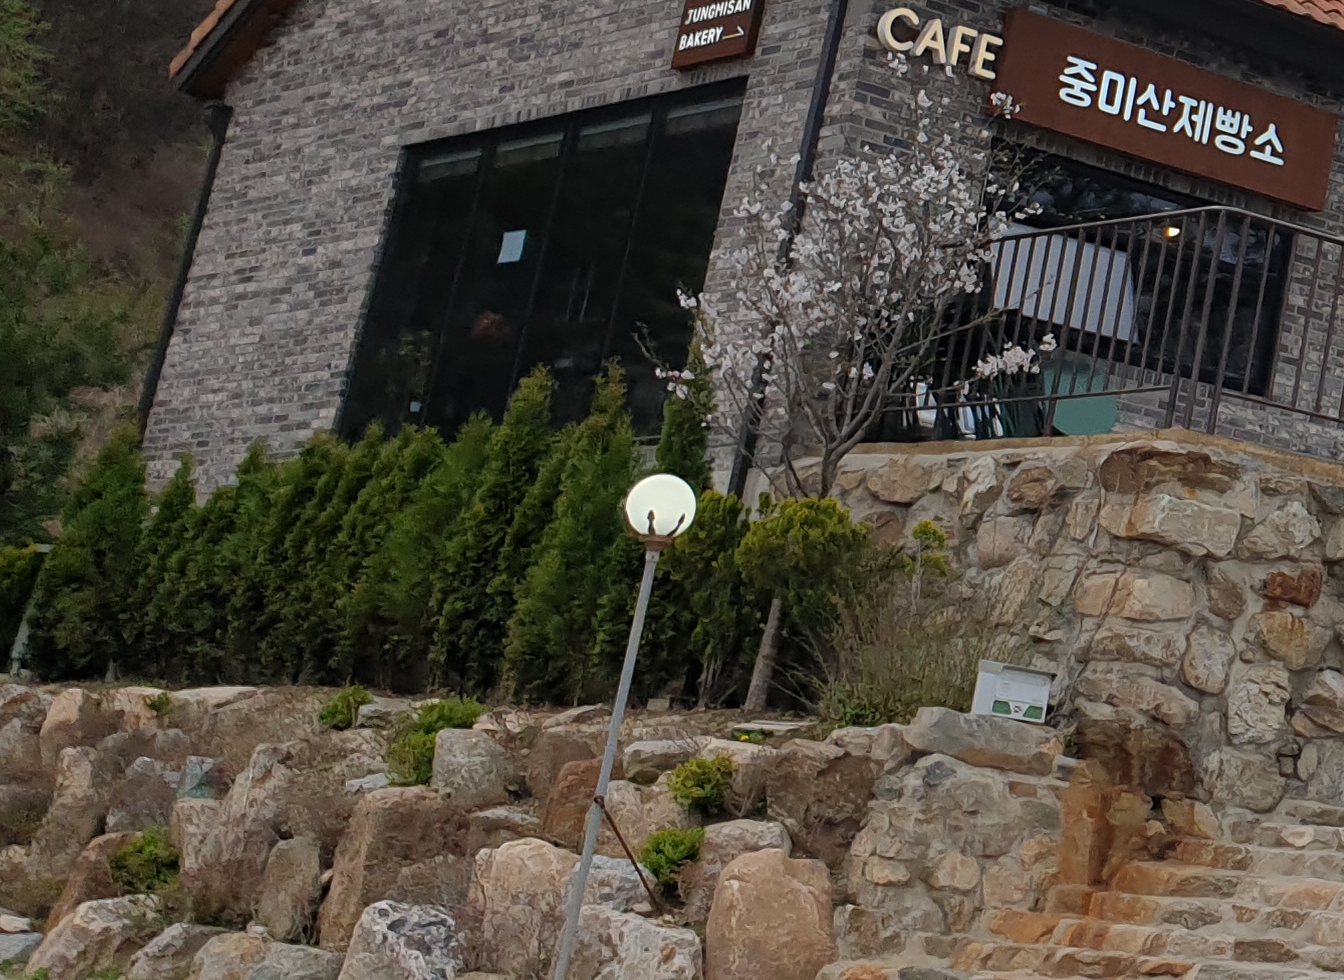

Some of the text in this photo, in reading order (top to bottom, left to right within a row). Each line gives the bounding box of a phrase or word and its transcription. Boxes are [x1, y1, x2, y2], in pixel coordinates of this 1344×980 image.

[678, 26, 724, 51] BAKERY
[876, 7, 1003, 80] CAFE
[1058, 54, 1286, 167] 중미산제빵소
